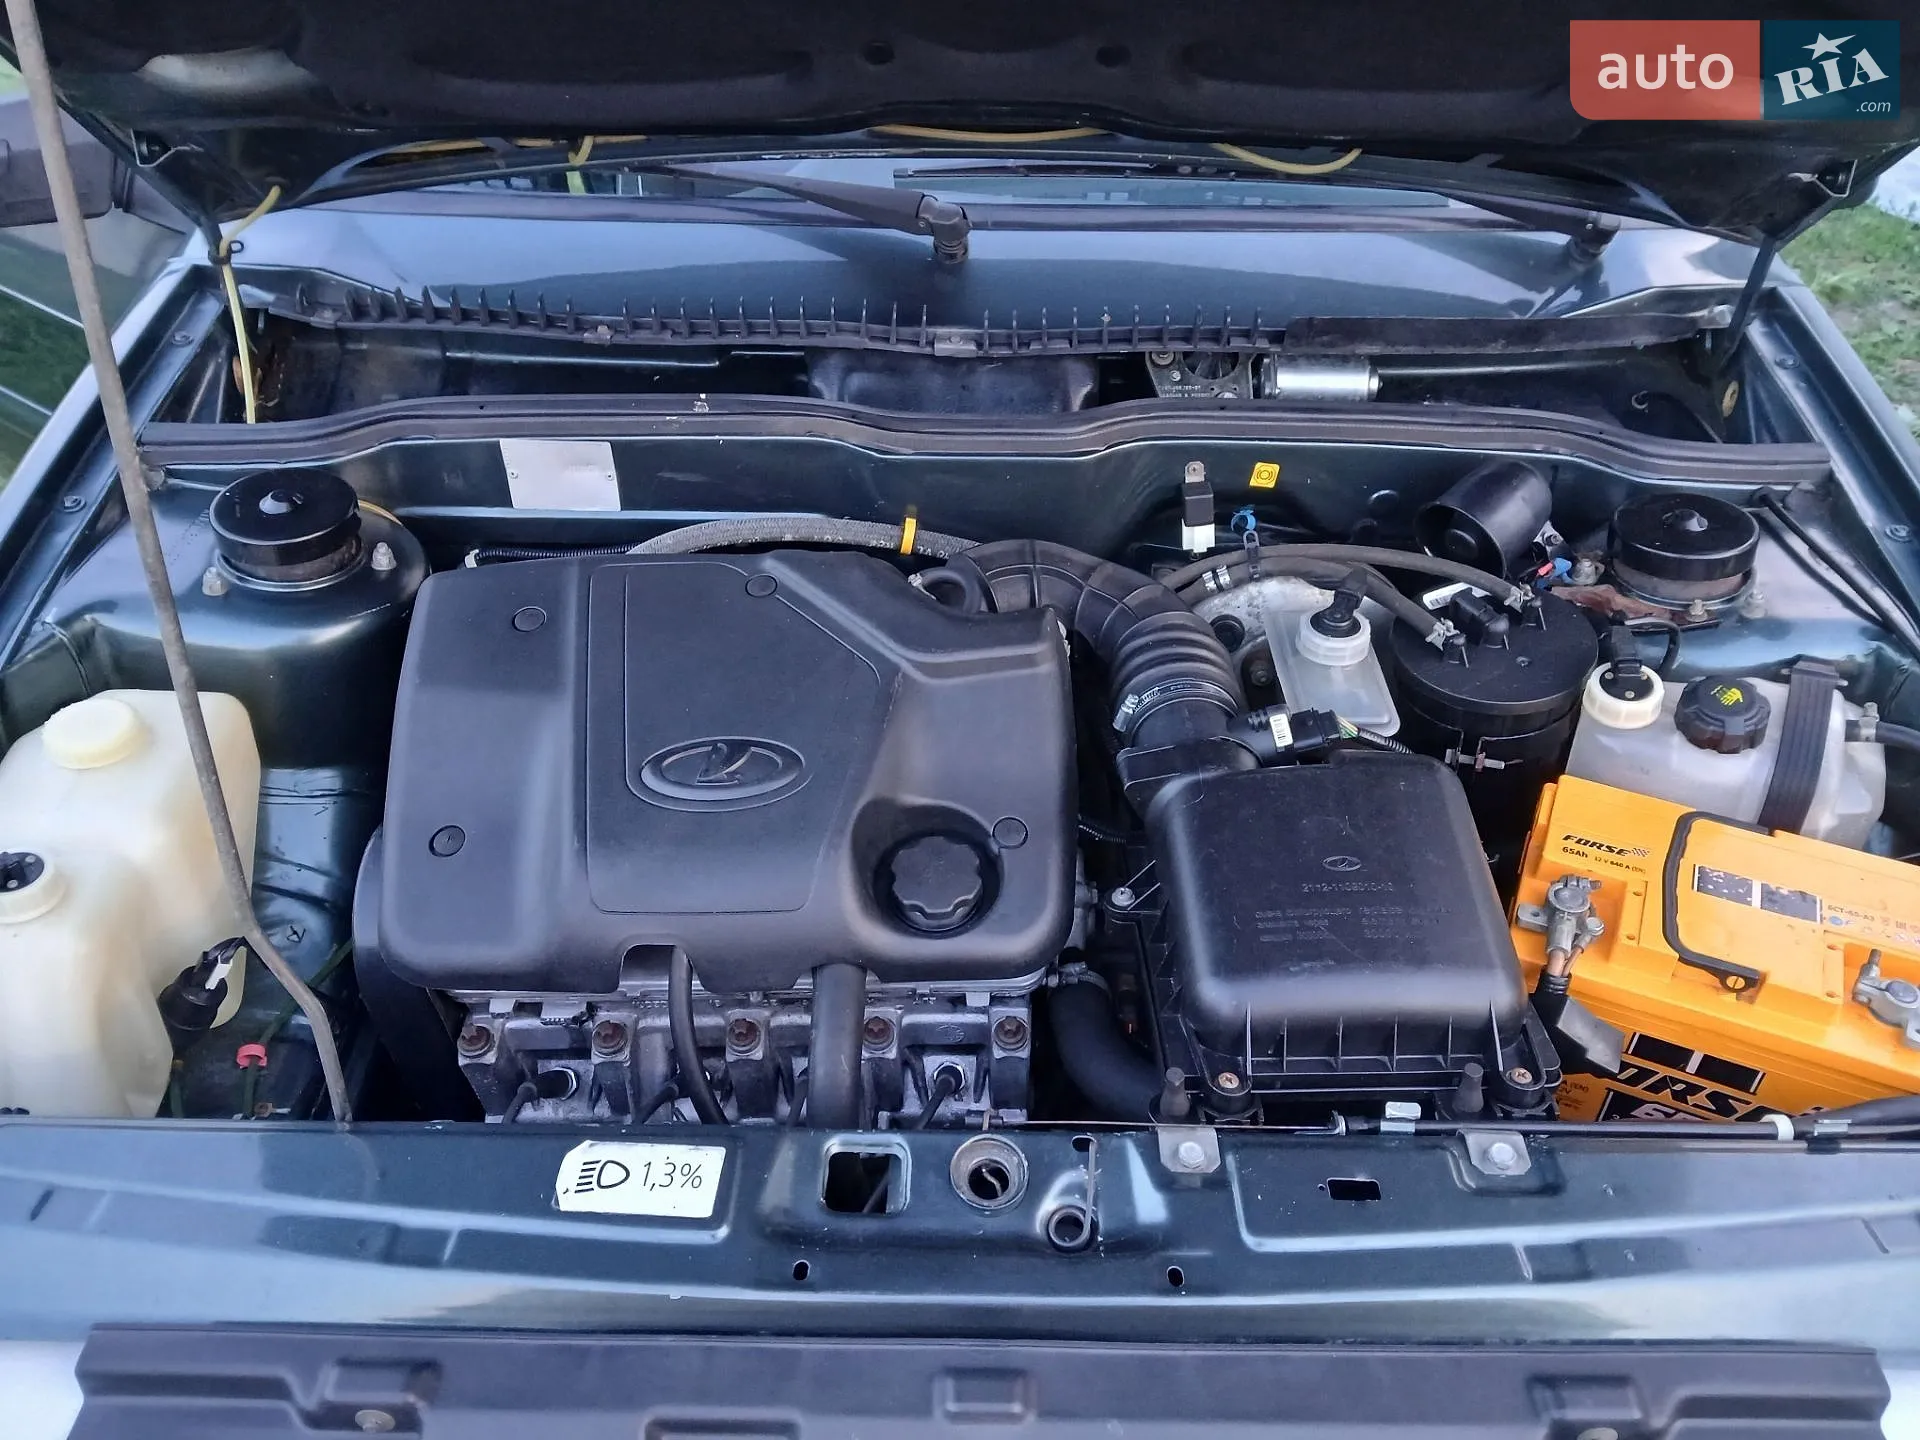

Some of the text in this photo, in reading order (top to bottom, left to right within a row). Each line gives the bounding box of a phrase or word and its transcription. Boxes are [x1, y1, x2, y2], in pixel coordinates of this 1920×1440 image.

[1562, 834, 1632, 857] FORSE
[1562, 846, 1588, 859] 65Ah
[643, 1161, 703, 1191] 1,3%
